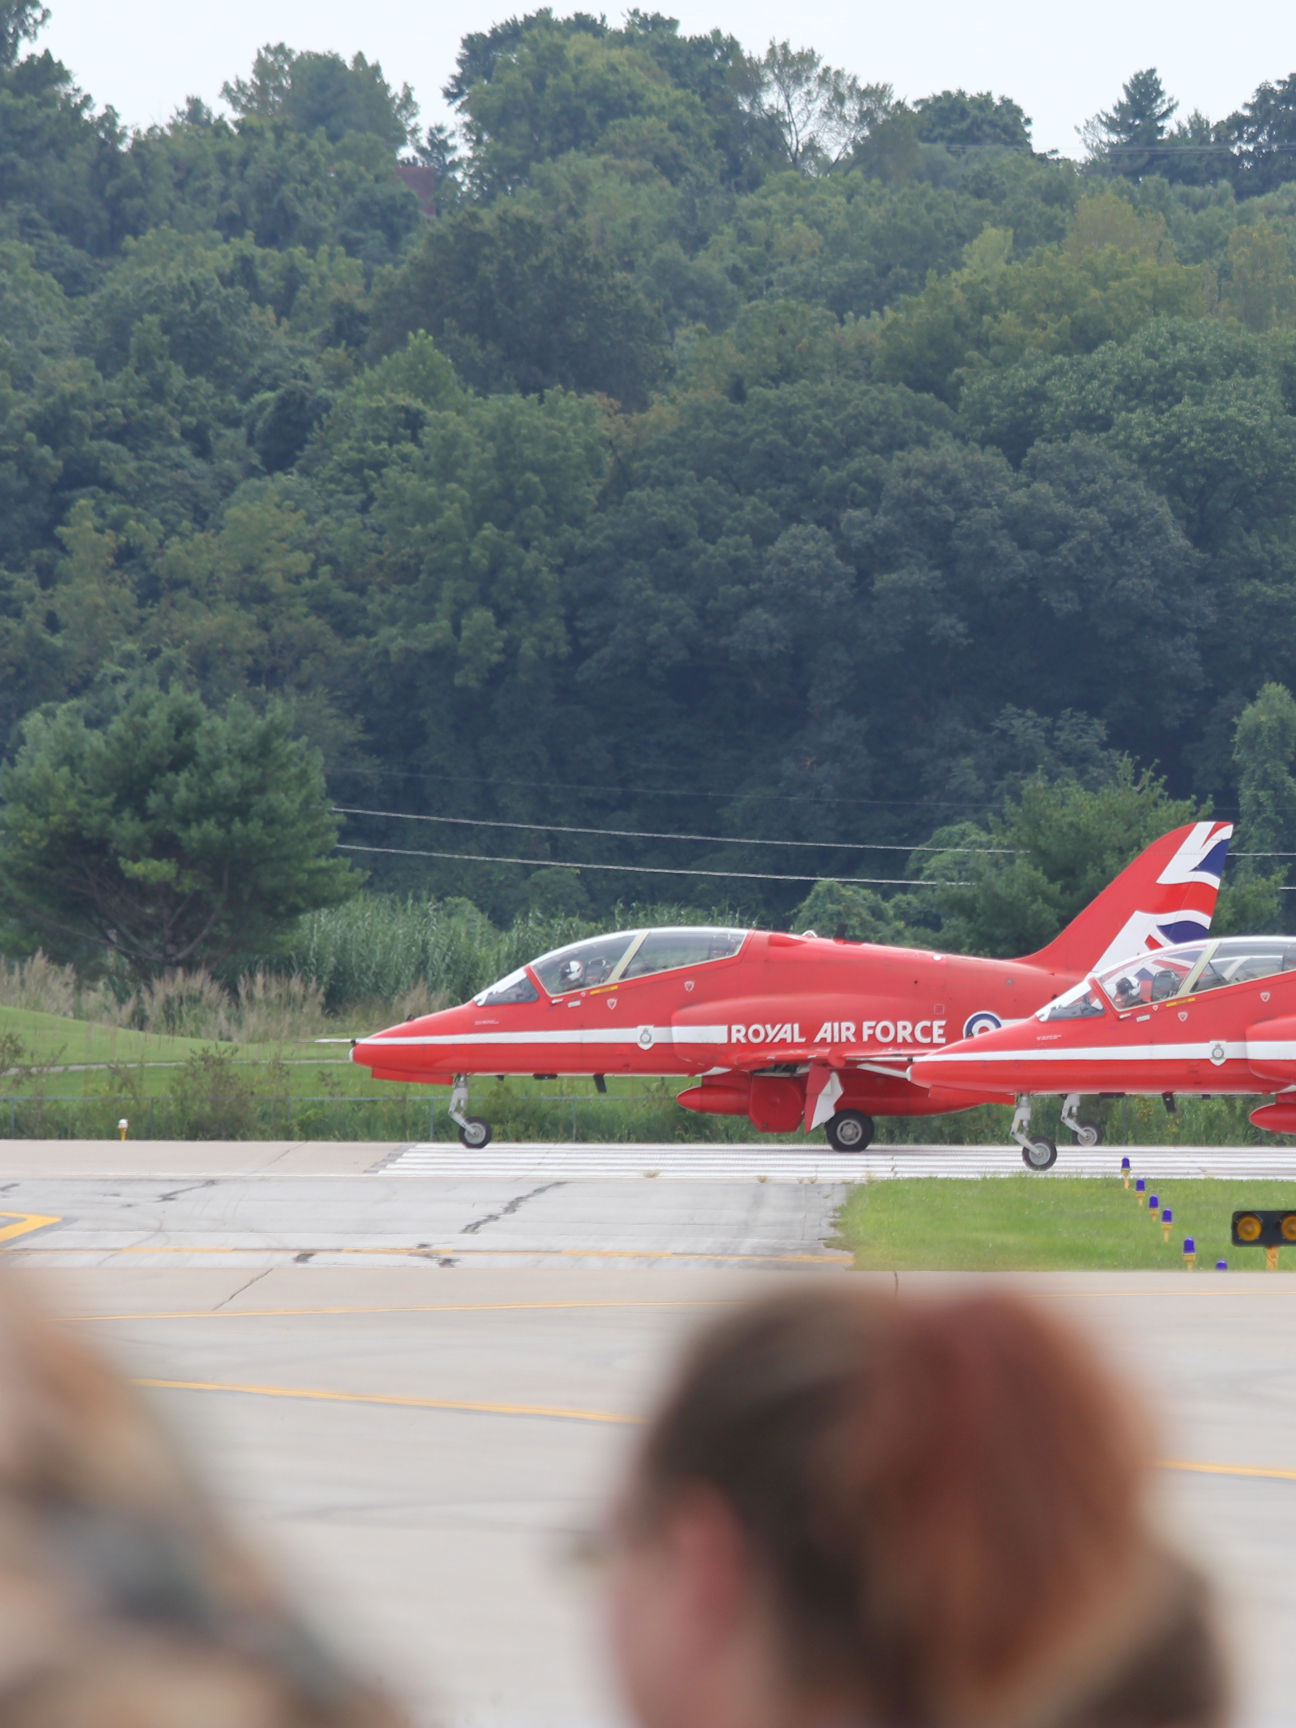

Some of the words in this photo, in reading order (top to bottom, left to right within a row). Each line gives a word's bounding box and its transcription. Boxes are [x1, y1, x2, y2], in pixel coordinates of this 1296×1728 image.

[731, 1023, 806, 1044] ROYAL
[813, 1022, 856, 1043] AIR
[862, 1020, 947, 1044] FORCE
